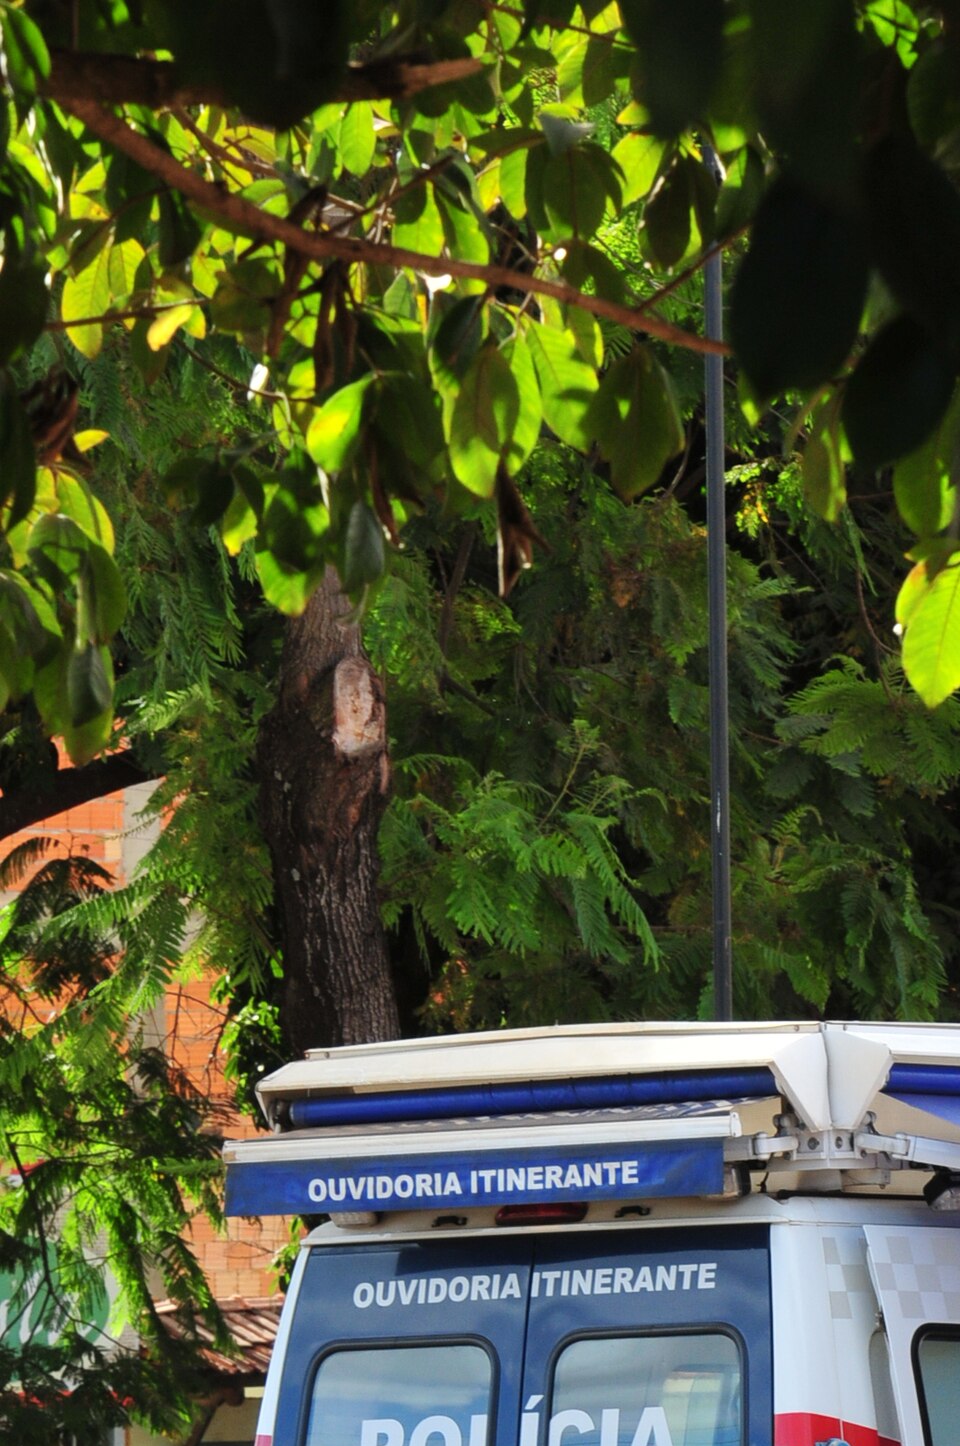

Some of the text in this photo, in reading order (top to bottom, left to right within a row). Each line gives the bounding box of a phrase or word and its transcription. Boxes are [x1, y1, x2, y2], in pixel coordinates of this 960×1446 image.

[308, 1160, 640, 1202] OUVIDORIA ITINERANTE
[353, 1262, 718, 1308] OUVIDORIA ITINERANTE
